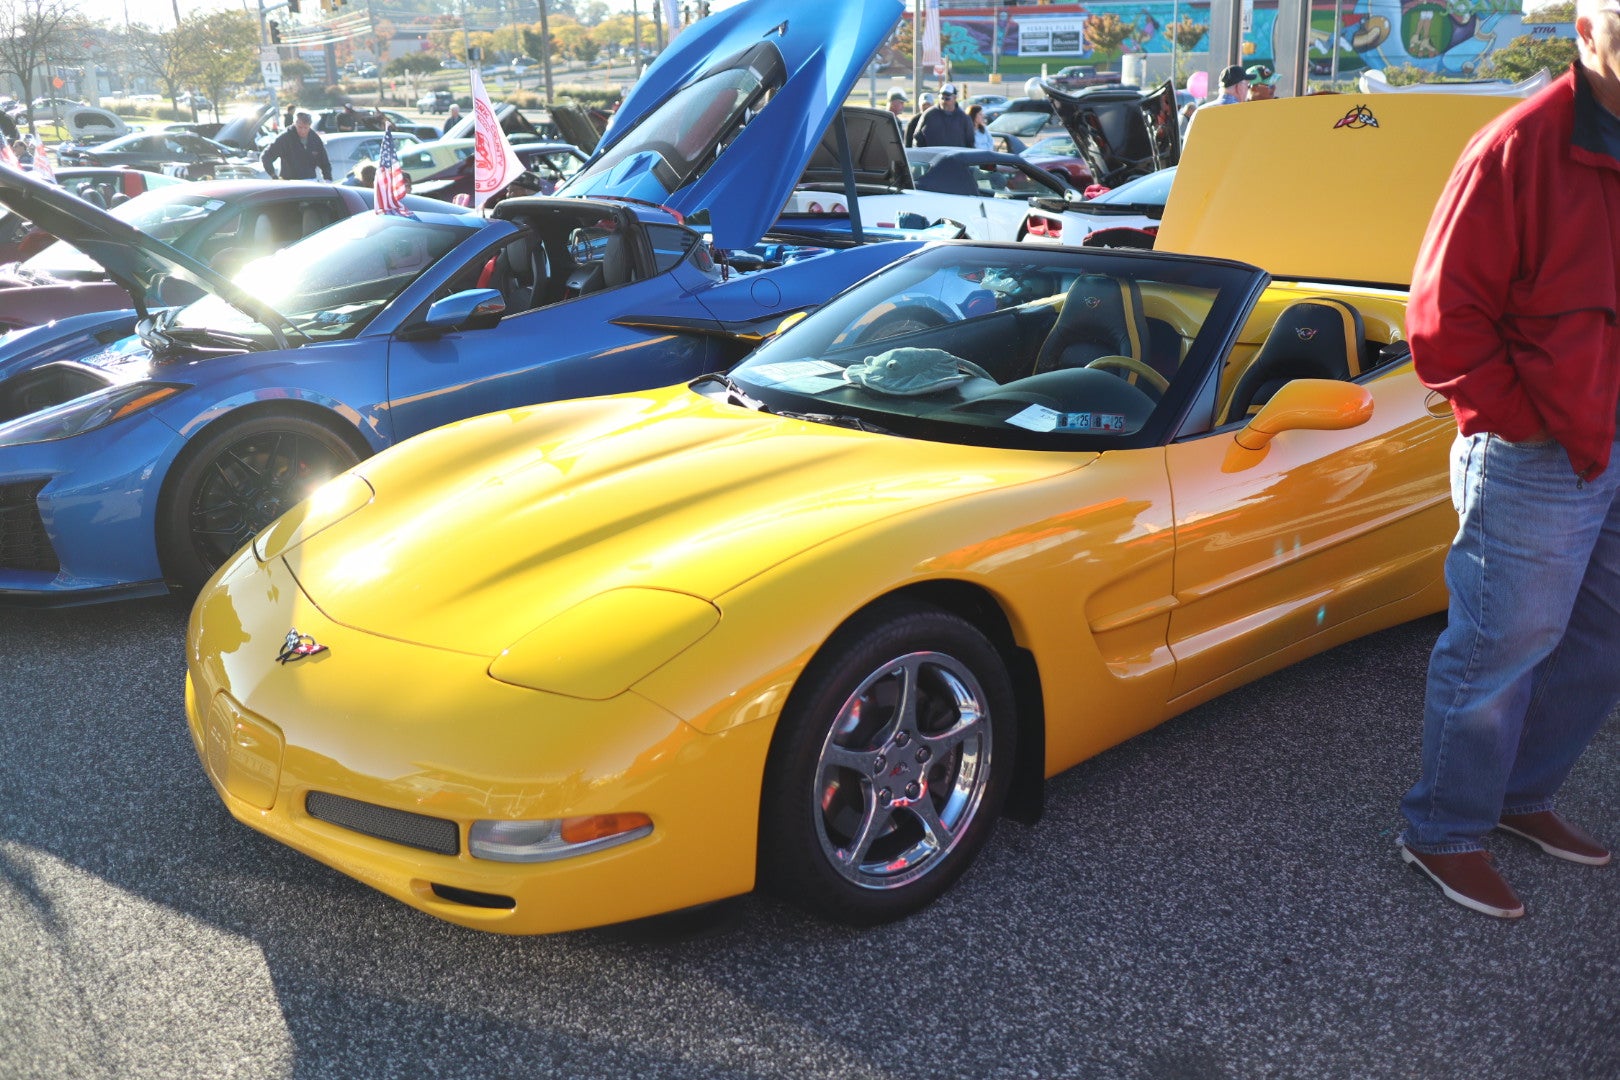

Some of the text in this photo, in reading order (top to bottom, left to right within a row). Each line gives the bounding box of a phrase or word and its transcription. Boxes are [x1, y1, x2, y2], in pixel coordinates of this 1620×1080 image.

[1532, 26, 1556, 34] XTRA
[265, 62, 278, 73] 41
[490, 124, 504, 167] COUNTY
[1079, 414, 1089, 426] 25
[1114, 416, 1123, 429] 25
